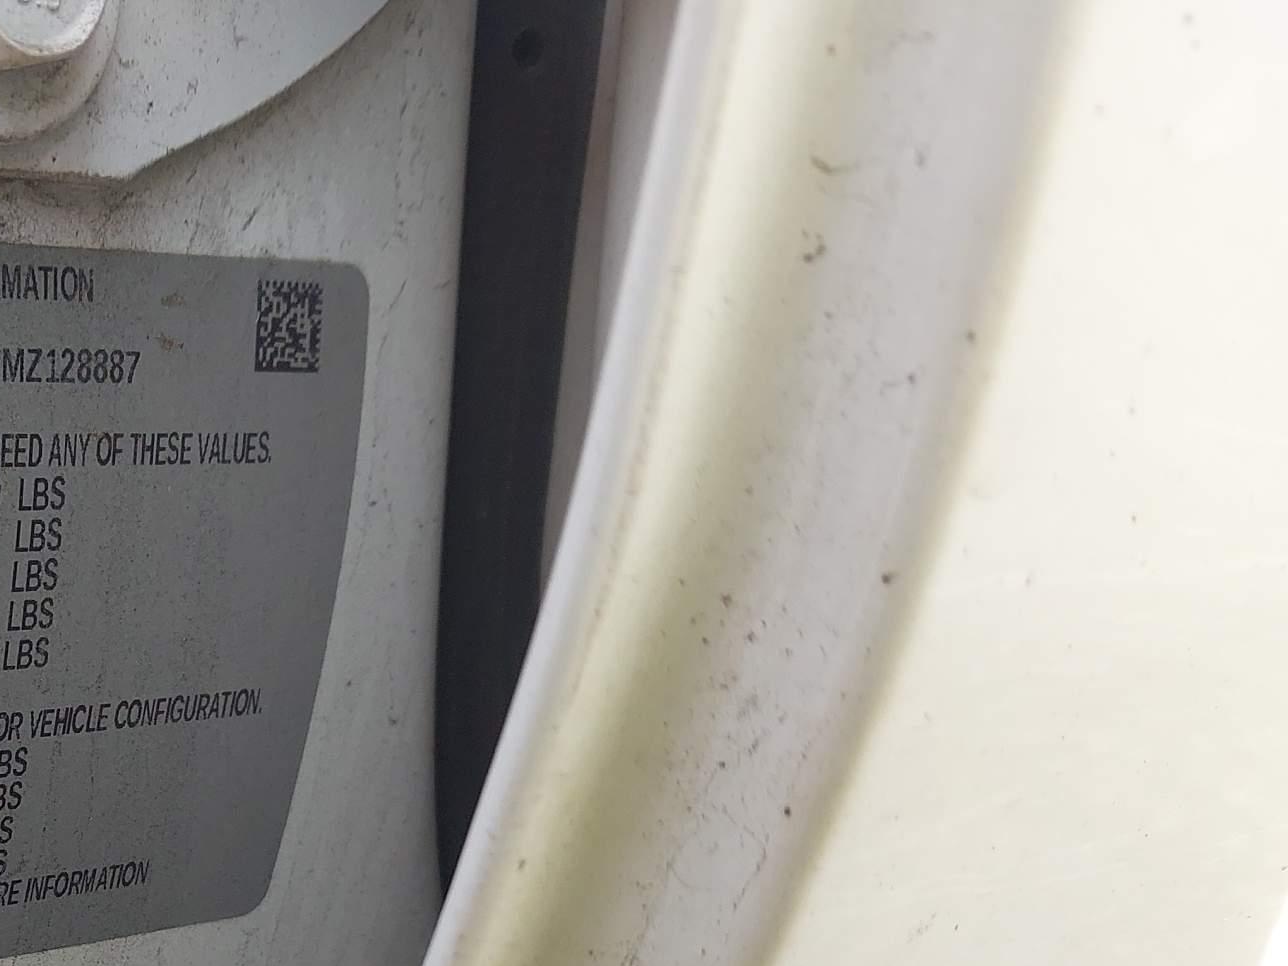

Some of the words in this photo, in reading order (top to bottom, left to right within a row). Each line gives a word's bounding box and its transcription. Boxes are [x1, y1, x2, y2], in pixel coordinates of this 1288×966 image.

[48, 433, 91, 467] ANY
[96, 433, 124, 466] OF
[128, 432, 192, 465] THESE
[197, 431, 272, 465] VALUES.
[18, 476, 66, 512] LBS
[14, 519, 63, 554] LBS
[11, 559, 59, 593] LBS
[7, 597, 54, 632] LBS
[2, 637, 50, 671] LBS
[30, 702, 111, 740] VEHICLE
[114, 688, 263, 731] CONFIGURATION.
[24, 859, 150, 903] INFORMATION
